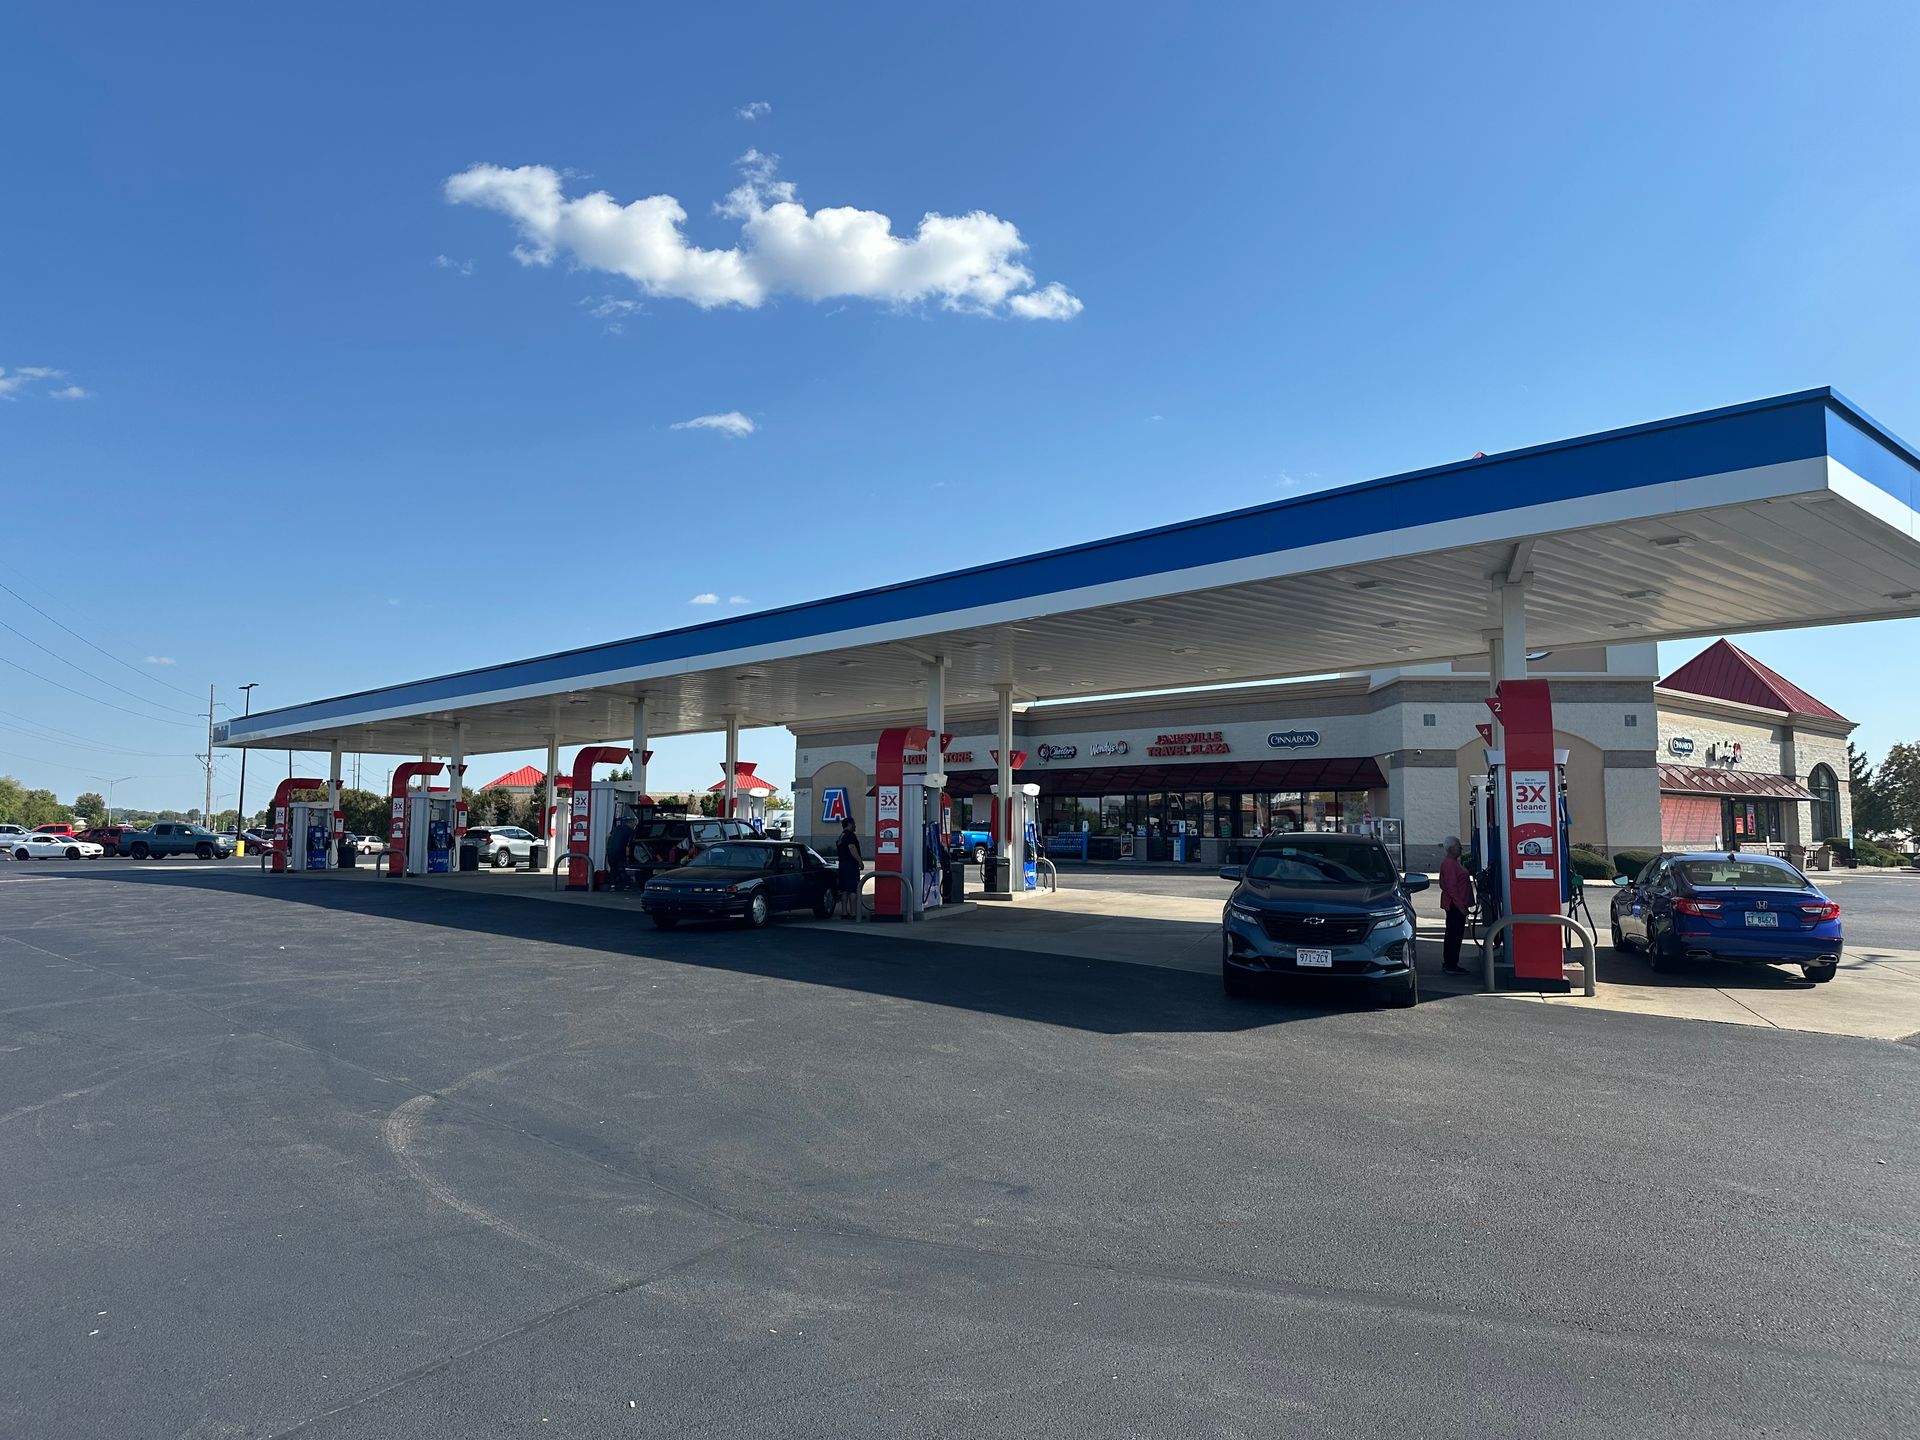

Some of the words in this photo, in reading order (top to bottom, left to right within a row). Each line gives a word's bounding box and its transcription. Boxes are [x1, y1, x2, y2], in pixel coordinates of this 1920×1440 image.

[1494, 702, 1502, 712] 2
[1482, 728, 1489, 736] 4
[1155, 732, 1222, 745] JANESVILLE
[1270, 735, 1315, 744] CINNABON
[1147, 745, 1190, 757] TRAVEL
[1191, 743, 1231, 755] PLAZA
[1516, 785, 1546, 802] 3X
[575, 797, 586, 806] 3X
[822, 788, 849, 821] TA
[880, 795, 897, 806] 3X
[1299, 953, 1329, 963] 971-ZCY
